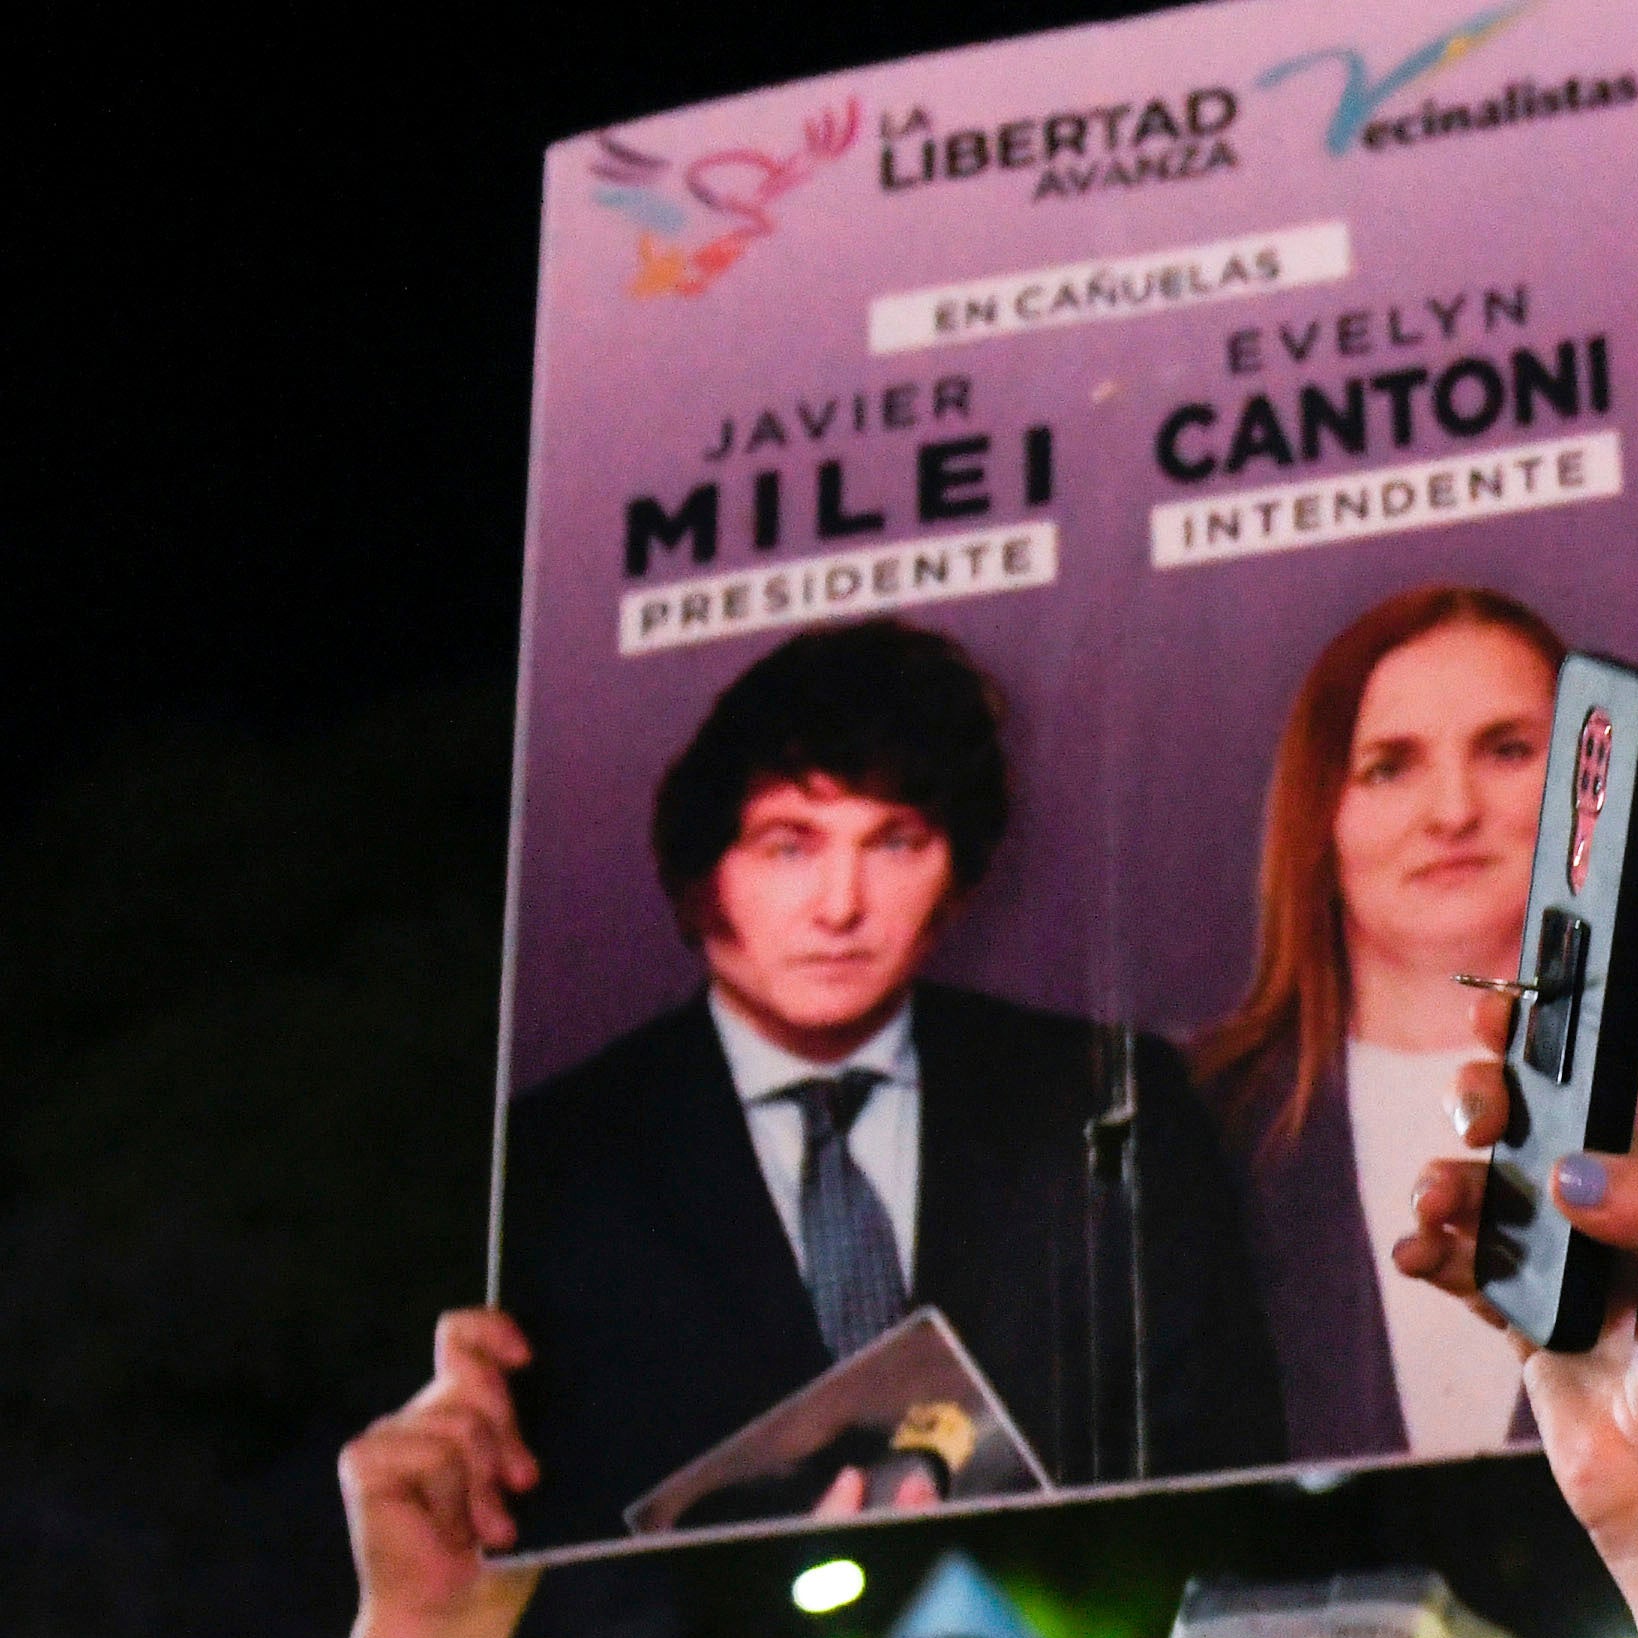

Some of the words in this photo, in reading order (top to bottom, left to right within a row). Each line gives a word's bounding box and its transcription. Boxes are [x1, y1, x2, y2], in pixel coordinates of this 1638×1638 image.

[878, 86, 1239, 193] LIBERTAD
[880, 105, 932, 139] LA
[1032, 140, 1239, 203] AVANZA
[933, 300, 997, 334] EN
[1015, 247, 1282, 310] CAÑUELAS
[1225, 283, 1529, 375] EVELYN
[705, 374, 972, 461] JAVIER
[1154, 336, 1614, 484] CANTONI
[623, 423, 1055, 579] MILEI
[1180, 450, 1586, 548] INTENDENTE
[638, 535, 1034, 638] PRESIDENTE
